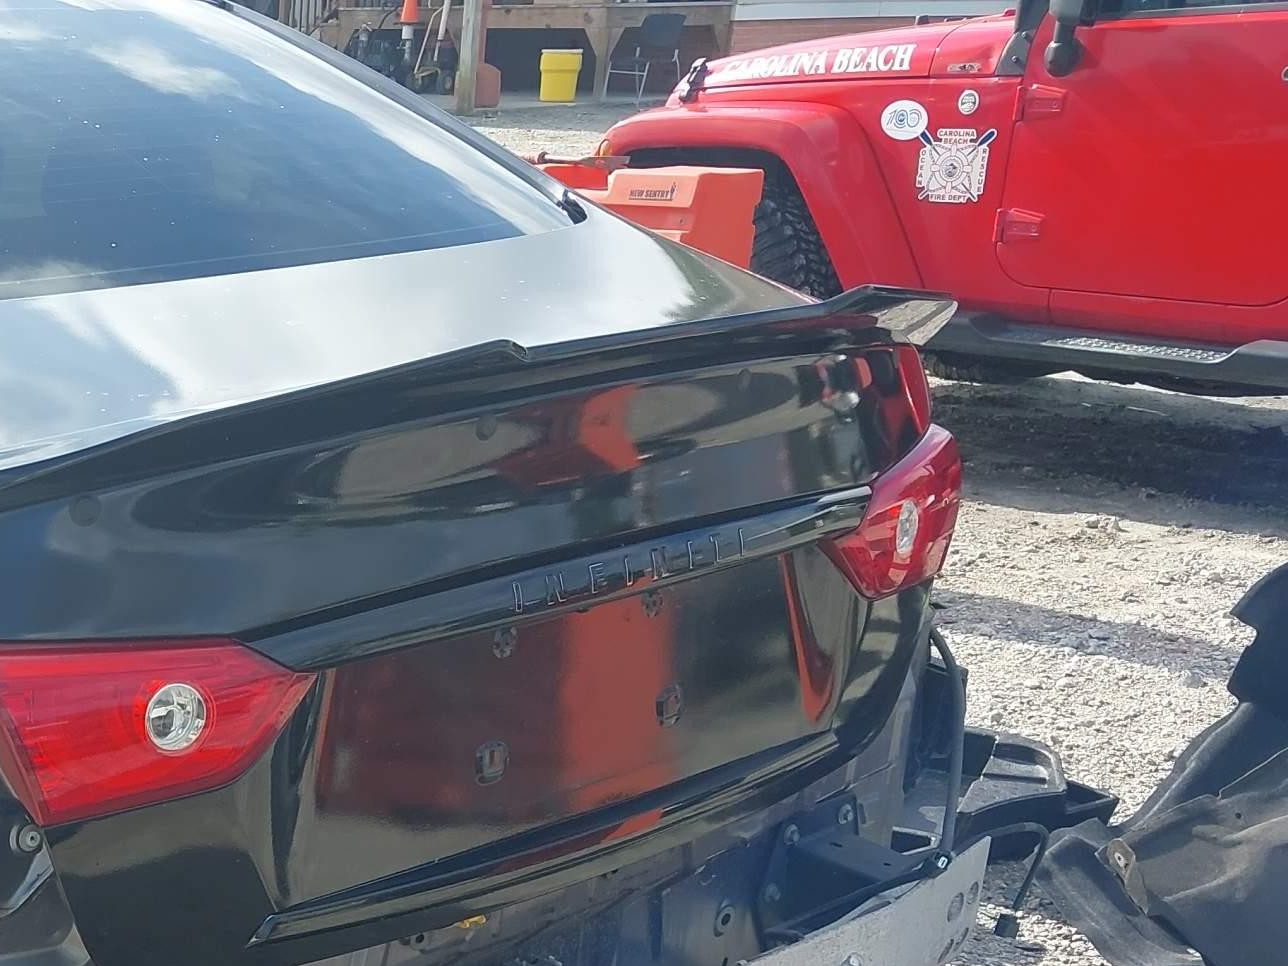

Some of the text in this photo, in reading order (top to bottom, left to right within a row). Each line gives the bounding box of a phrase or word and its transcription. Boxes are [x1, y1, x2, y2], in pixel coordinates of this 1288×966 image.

[721, 43, 918, 78] CAROLINA BEACH
[917, 149, 927, 186] OCEAN
[976, 148, 988, 193] RESCUE
[645, 189, 670, 198] SENTRY
[929, 193, 947, 201] FIRE
